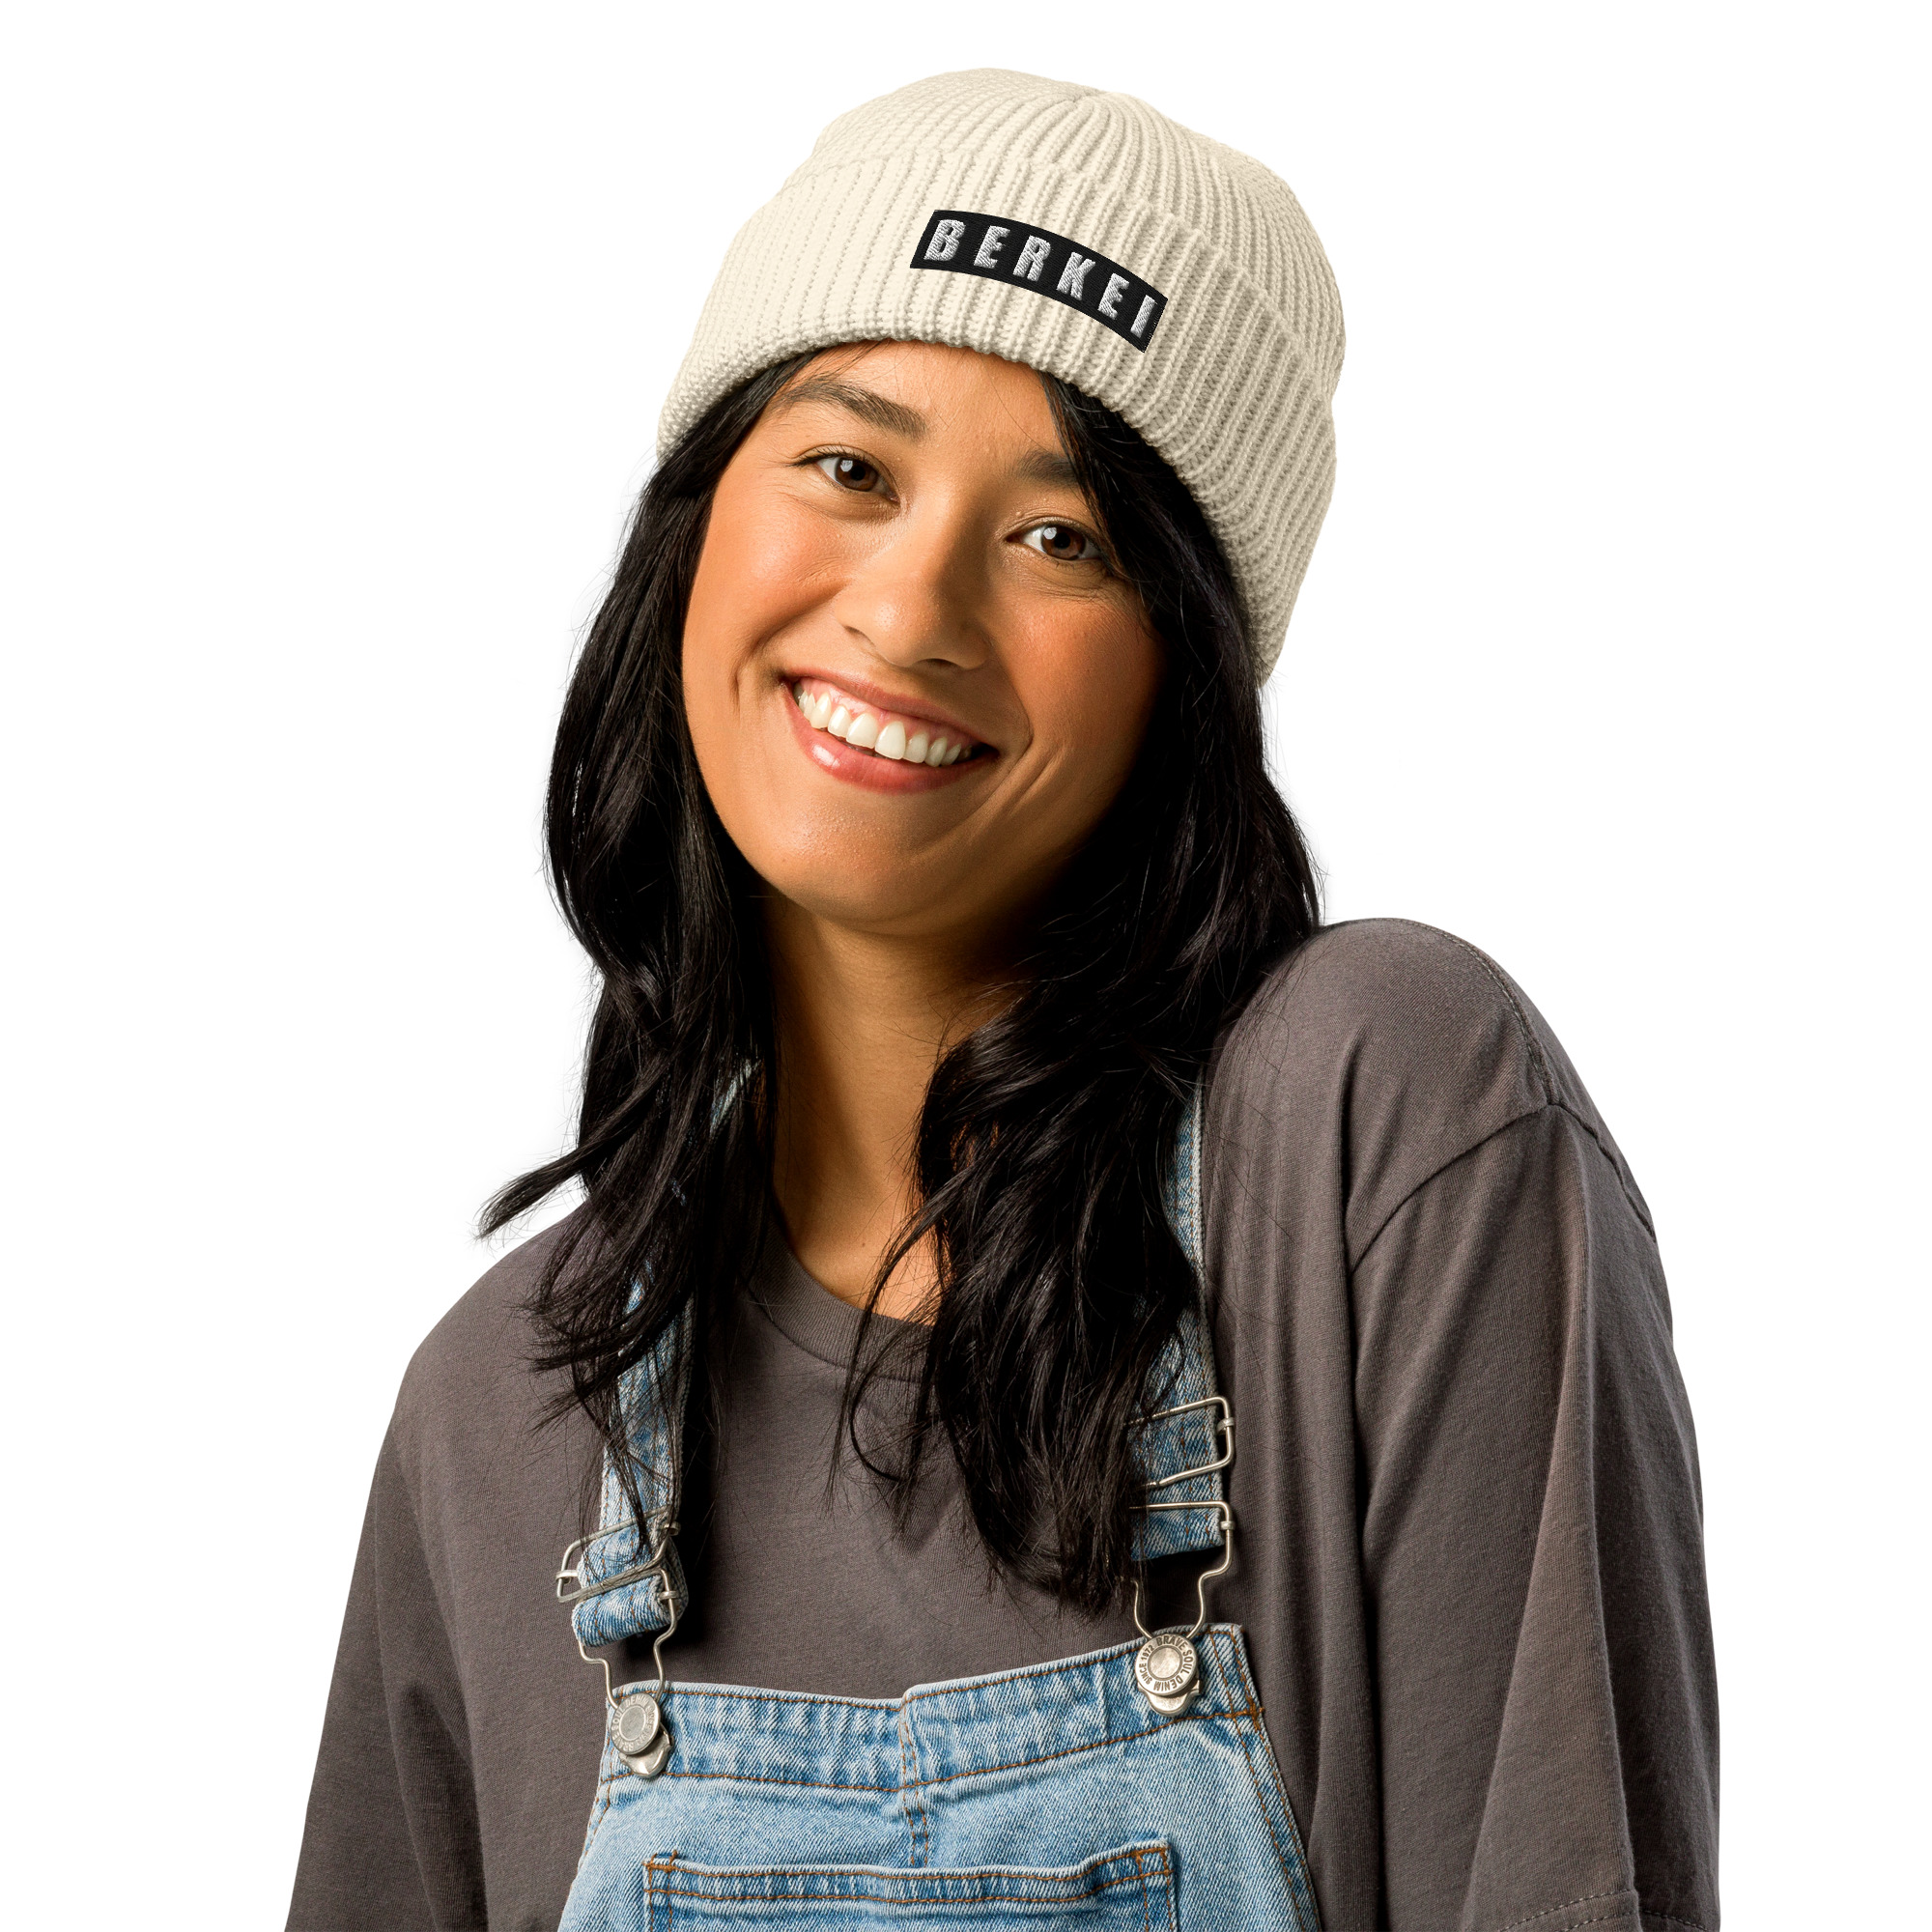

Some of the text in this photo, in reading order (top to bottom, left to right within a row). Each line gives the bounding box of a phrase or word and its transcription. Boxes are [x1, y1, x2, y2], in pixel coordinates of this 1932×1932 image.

[923, 218, 1157, 338] BERKEI
[1139, 1635, 1194, 1691] BRAVE SOUL DENIM SINCE 1972
[611, 1706, 626, 1731] SOUL
